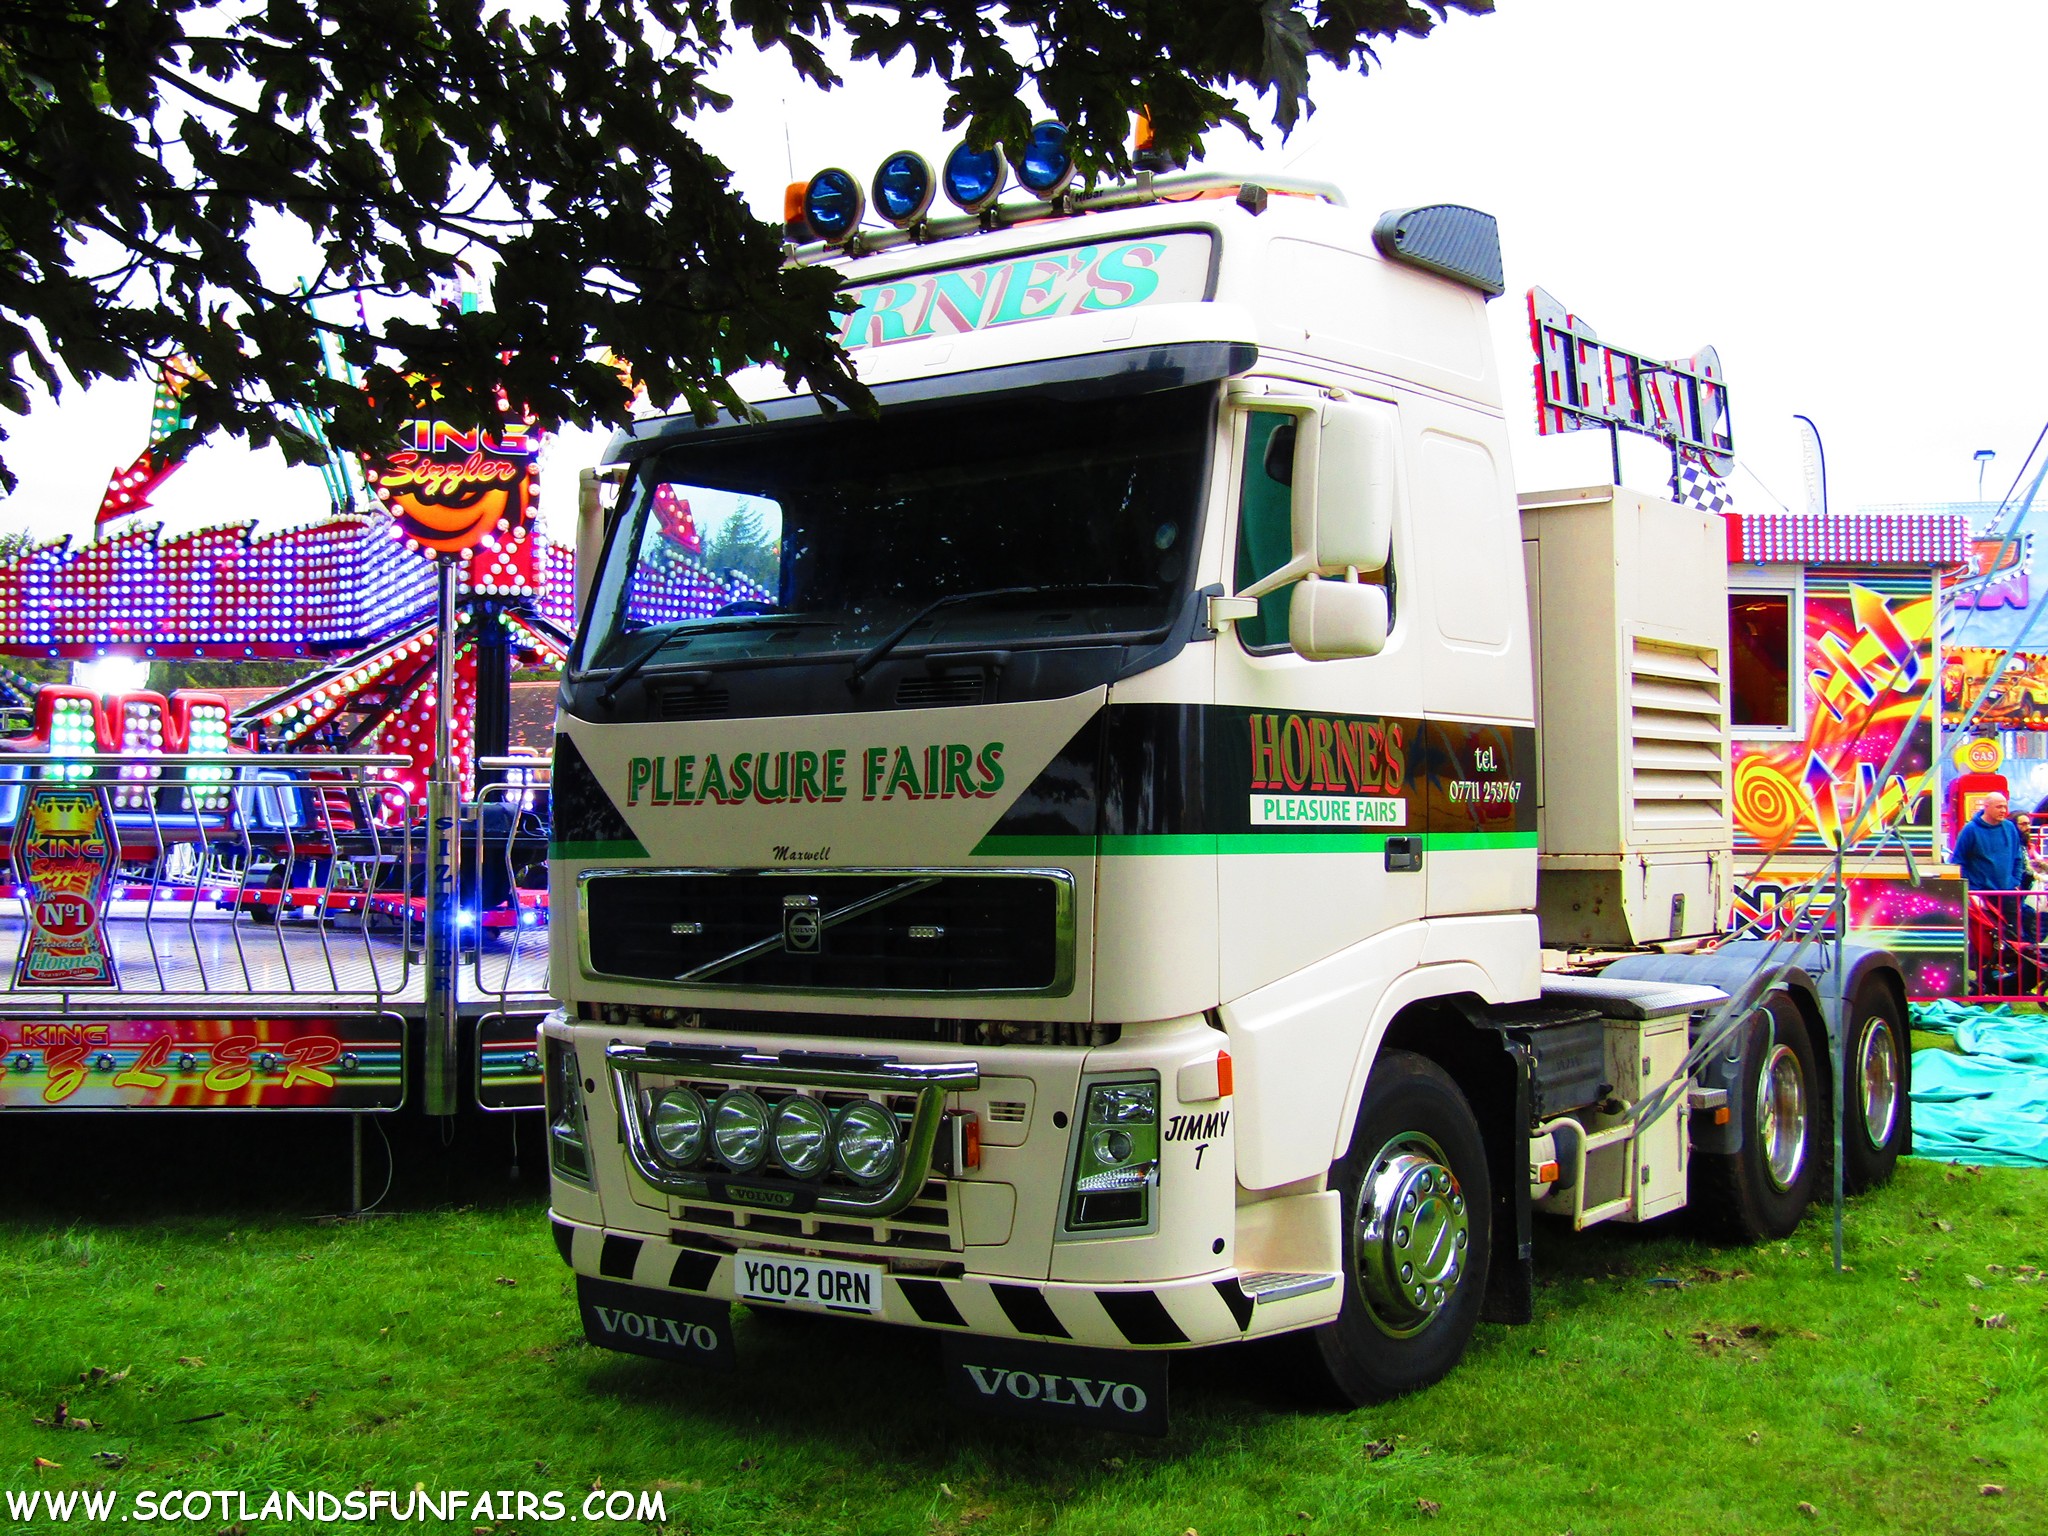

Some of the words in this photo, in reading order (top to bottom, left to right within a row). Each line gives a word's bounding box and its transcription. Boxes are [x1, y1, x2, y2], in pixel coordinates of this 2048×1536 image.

[828, 243, 1168, 347] RNE'S
[380, 451, 516, 496] Sizzler
[1250, 713, 1405, 795] HORNE'S
[1972, 751, 1994, 761] GAS
[627, 750, 847, 806] PLEASURE
[862, 741, 1006, 801] FAIRS
[1449, 780, 1480, 802] 07711
[1483, 780, 1521, 804] 253767
[1264, 798, 1351, 821] PLEASURE
[1355, 801, 1397, 822] FAIRS
[26, 838, 105, 857] KING
[772, 845, 831, 861] Maxwell
[23, 1025, 109, 1046] KING
[0, 1035, 342, 1103] ZLER
[1164, 1110, 1230, 1142] JIMMY
[1194, 1143, 1209, 1170] T
[735, 1188, 786, 1204] VOLVO
[817, 1269, 871, 1305] ORN
[593, 1305, 719, 1351] VOLVO
[962, 1364, 1148, 1413] VOLVO
